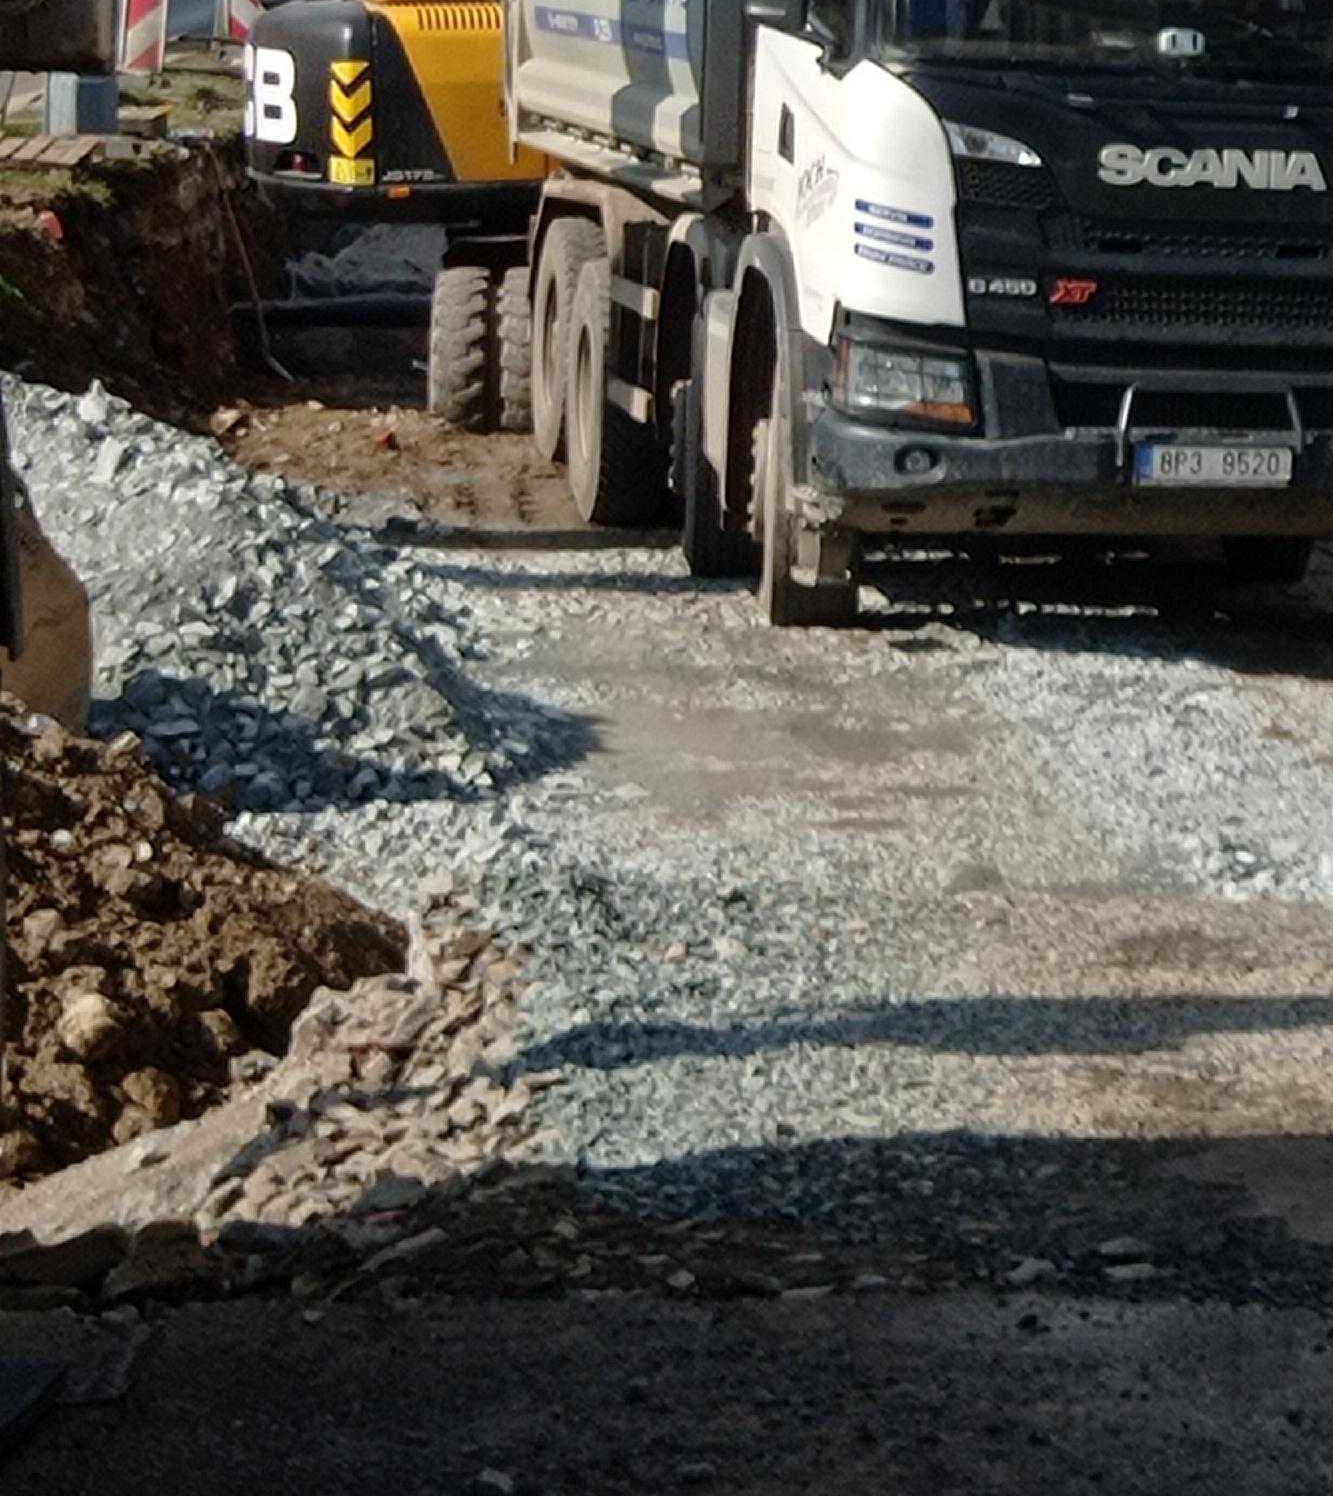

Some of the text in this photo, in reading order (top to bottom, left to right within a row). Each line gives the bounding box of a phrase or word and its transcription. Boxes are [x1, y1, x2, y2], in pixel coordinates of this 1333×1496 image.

[245, 44, 298, 144] B
[1096, 143, 1327, 192] SCANIA
[1160, 450, 1281, 476] 8P3 9520
